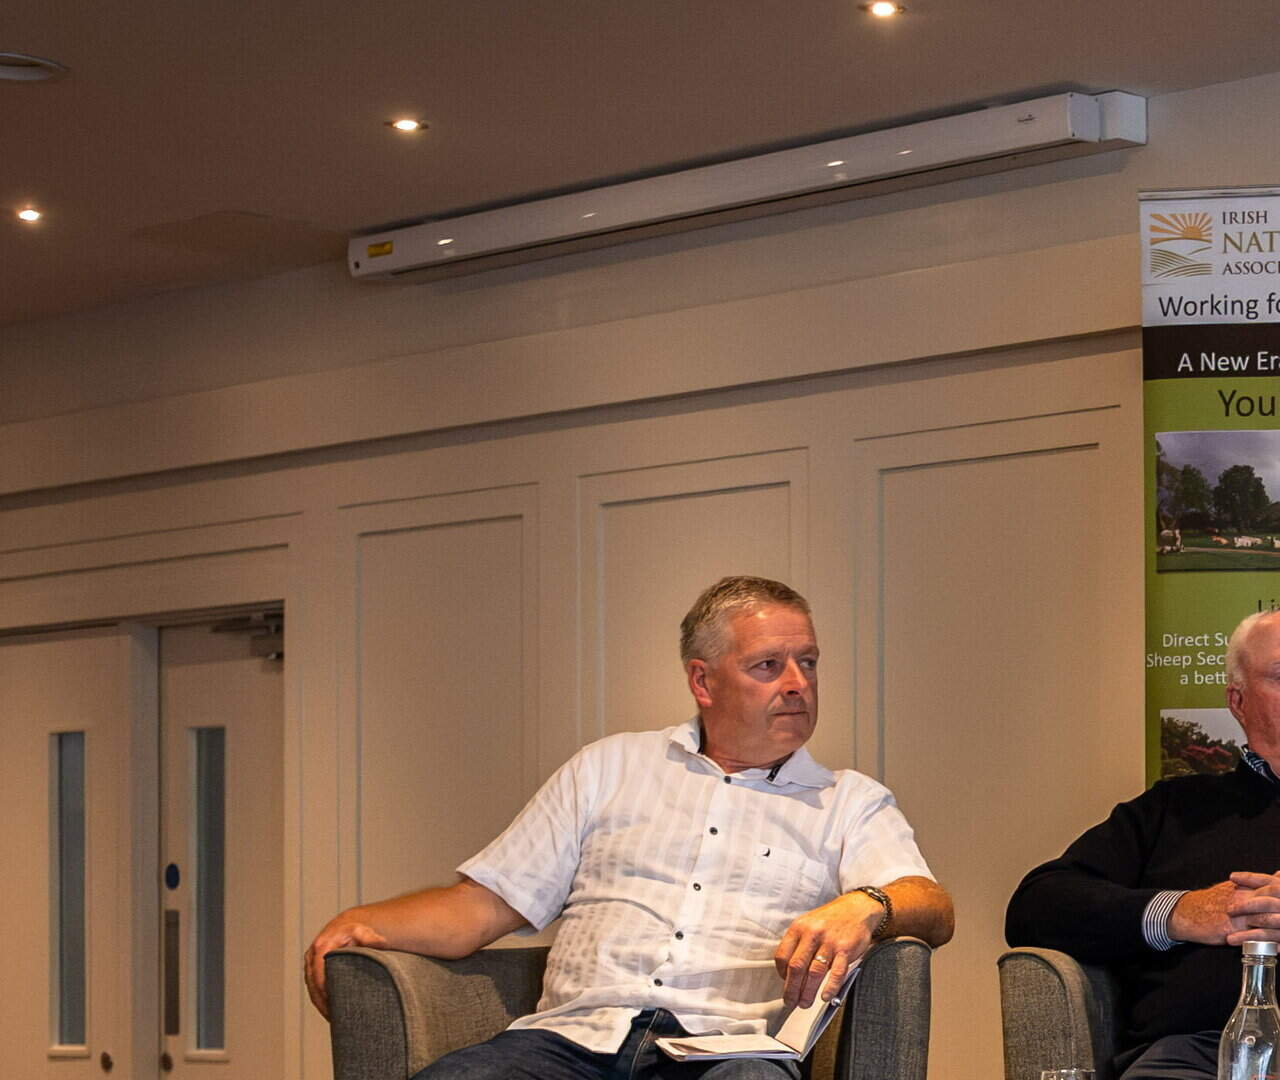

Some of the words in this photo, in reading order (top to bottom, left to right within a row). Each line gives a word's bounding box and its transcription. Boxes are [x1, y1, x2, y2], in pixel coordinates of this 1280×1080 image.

[1222, 210, 1268, 225] IRISH
[1158, 293, 1259, 320] Working
[1177, 353, 1194, 372] A
[1200, 352, 1250, 371] New
[1162, 633, 1209, 648] Direct
[1146, 653, 1191, 668] Sheep
[1197, 652, 1225, 666] Sec
[1180, 674, 1189, 685] a
[1194, 670, 1228, 685] bett
